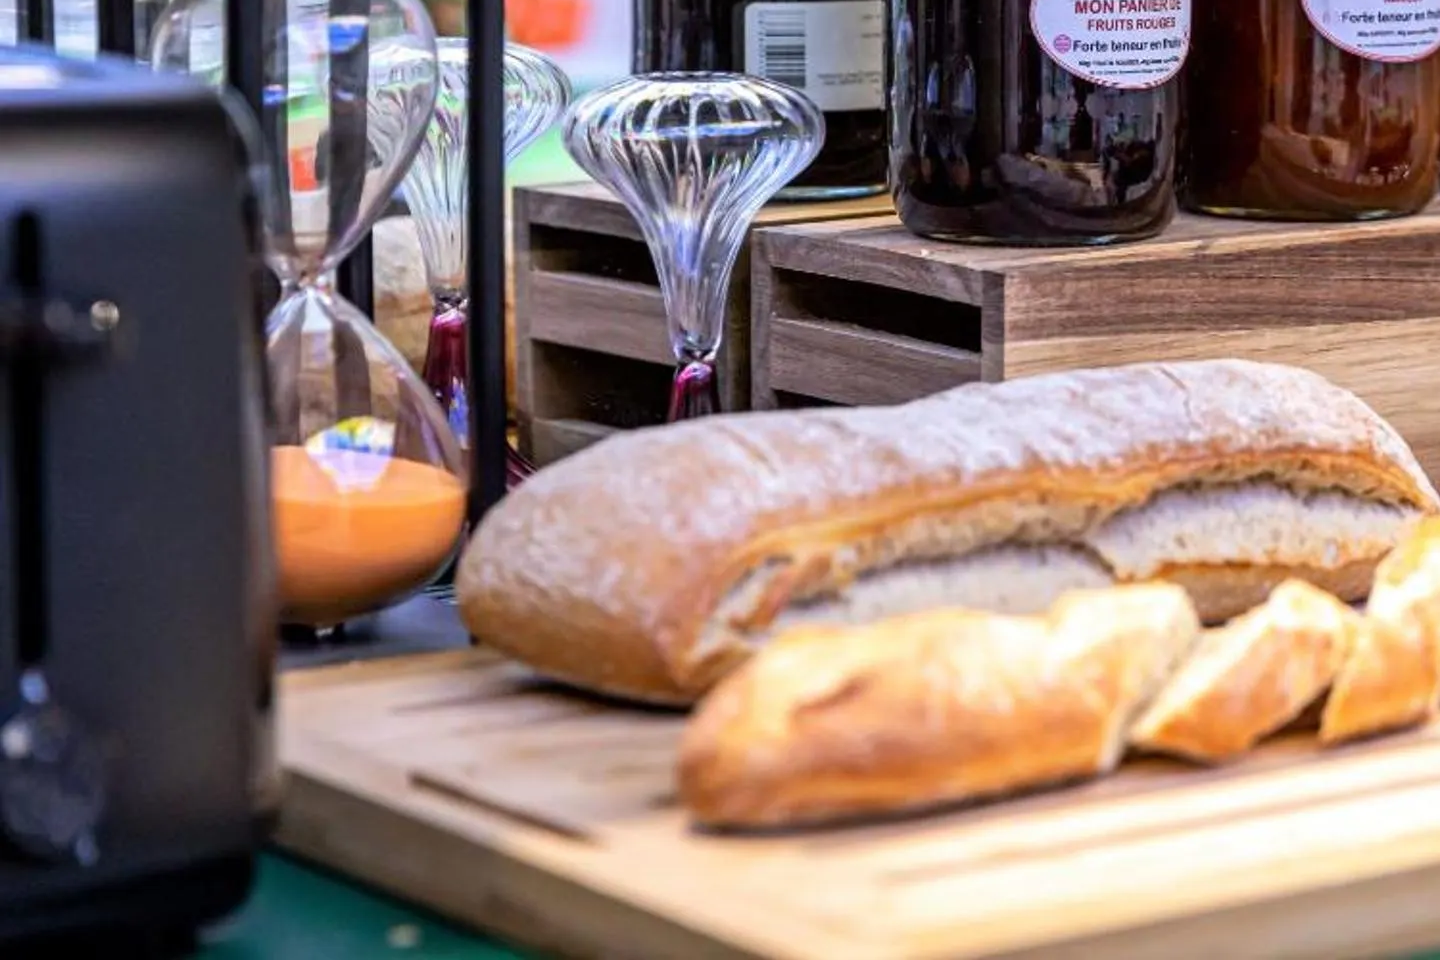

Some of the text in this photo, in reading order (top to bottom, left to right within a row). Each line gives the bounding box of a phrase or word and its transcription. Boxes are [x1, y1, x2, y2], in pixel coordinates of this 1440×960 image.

[1075, 0, 1114, 14] MON
[1088, 17, 1176, 31] FRUITS ROUGES
[1341, 10, 1374, 24] Forte
[1378, 11, 1413, 23] teneur
[1073, 40, 1108, 52] Forte
[1111, 40, 1149, 52] teneur
[1150, 41, 1162, 51] en
